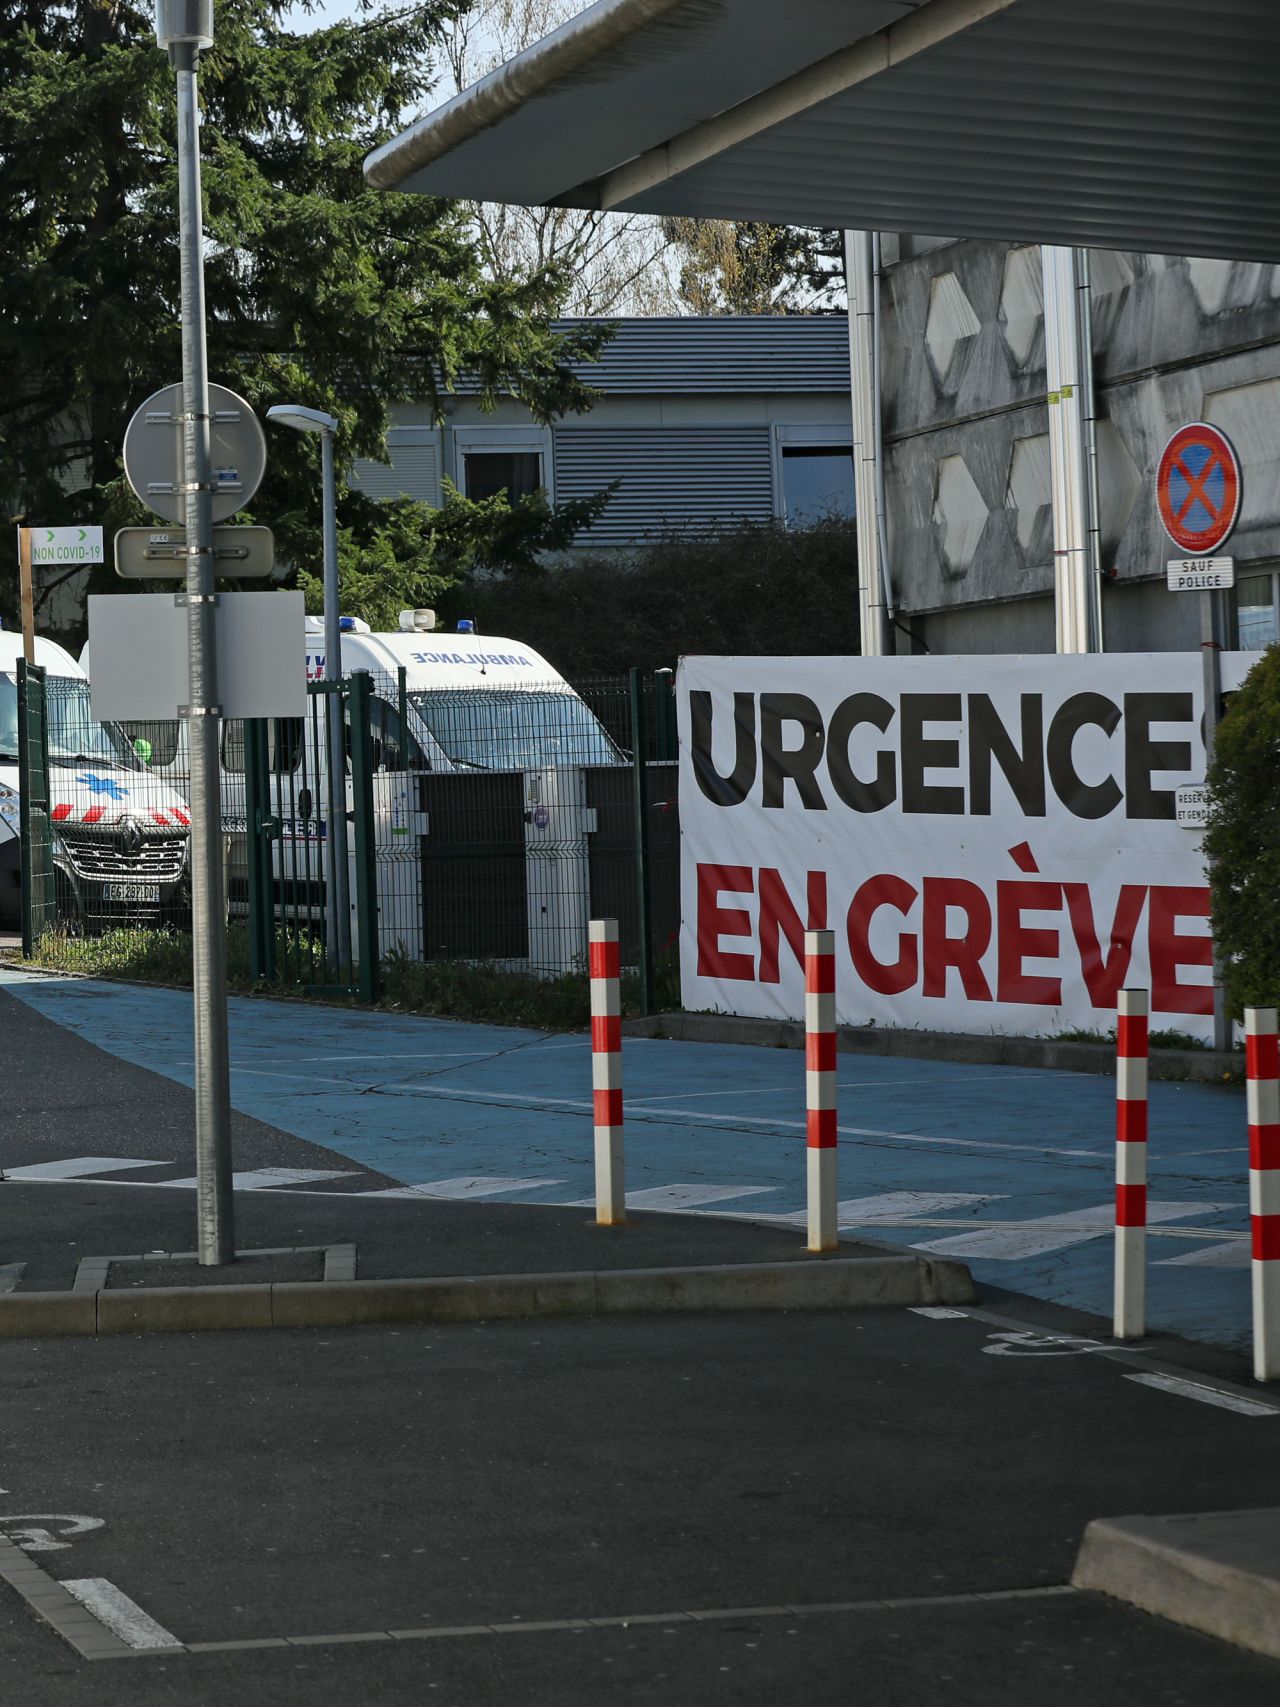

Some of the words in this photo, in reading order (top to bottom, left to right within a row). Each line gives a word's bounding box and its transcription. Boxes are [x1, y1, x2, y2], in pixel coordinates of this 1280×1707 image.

[33, 547, 55, 560] NON
[57, 545, 100, 560] COVID-19
[1182, 560, 1213, 573] SAUF
[1178, 575, 1222, 588] POLICE
[689, 690, 1222, 819] URGENCE
[1177, 810, 1186, 820] ET
[696, 862, 827, 984] EN
[847, 842, 1214, 1016] GRÈVE
